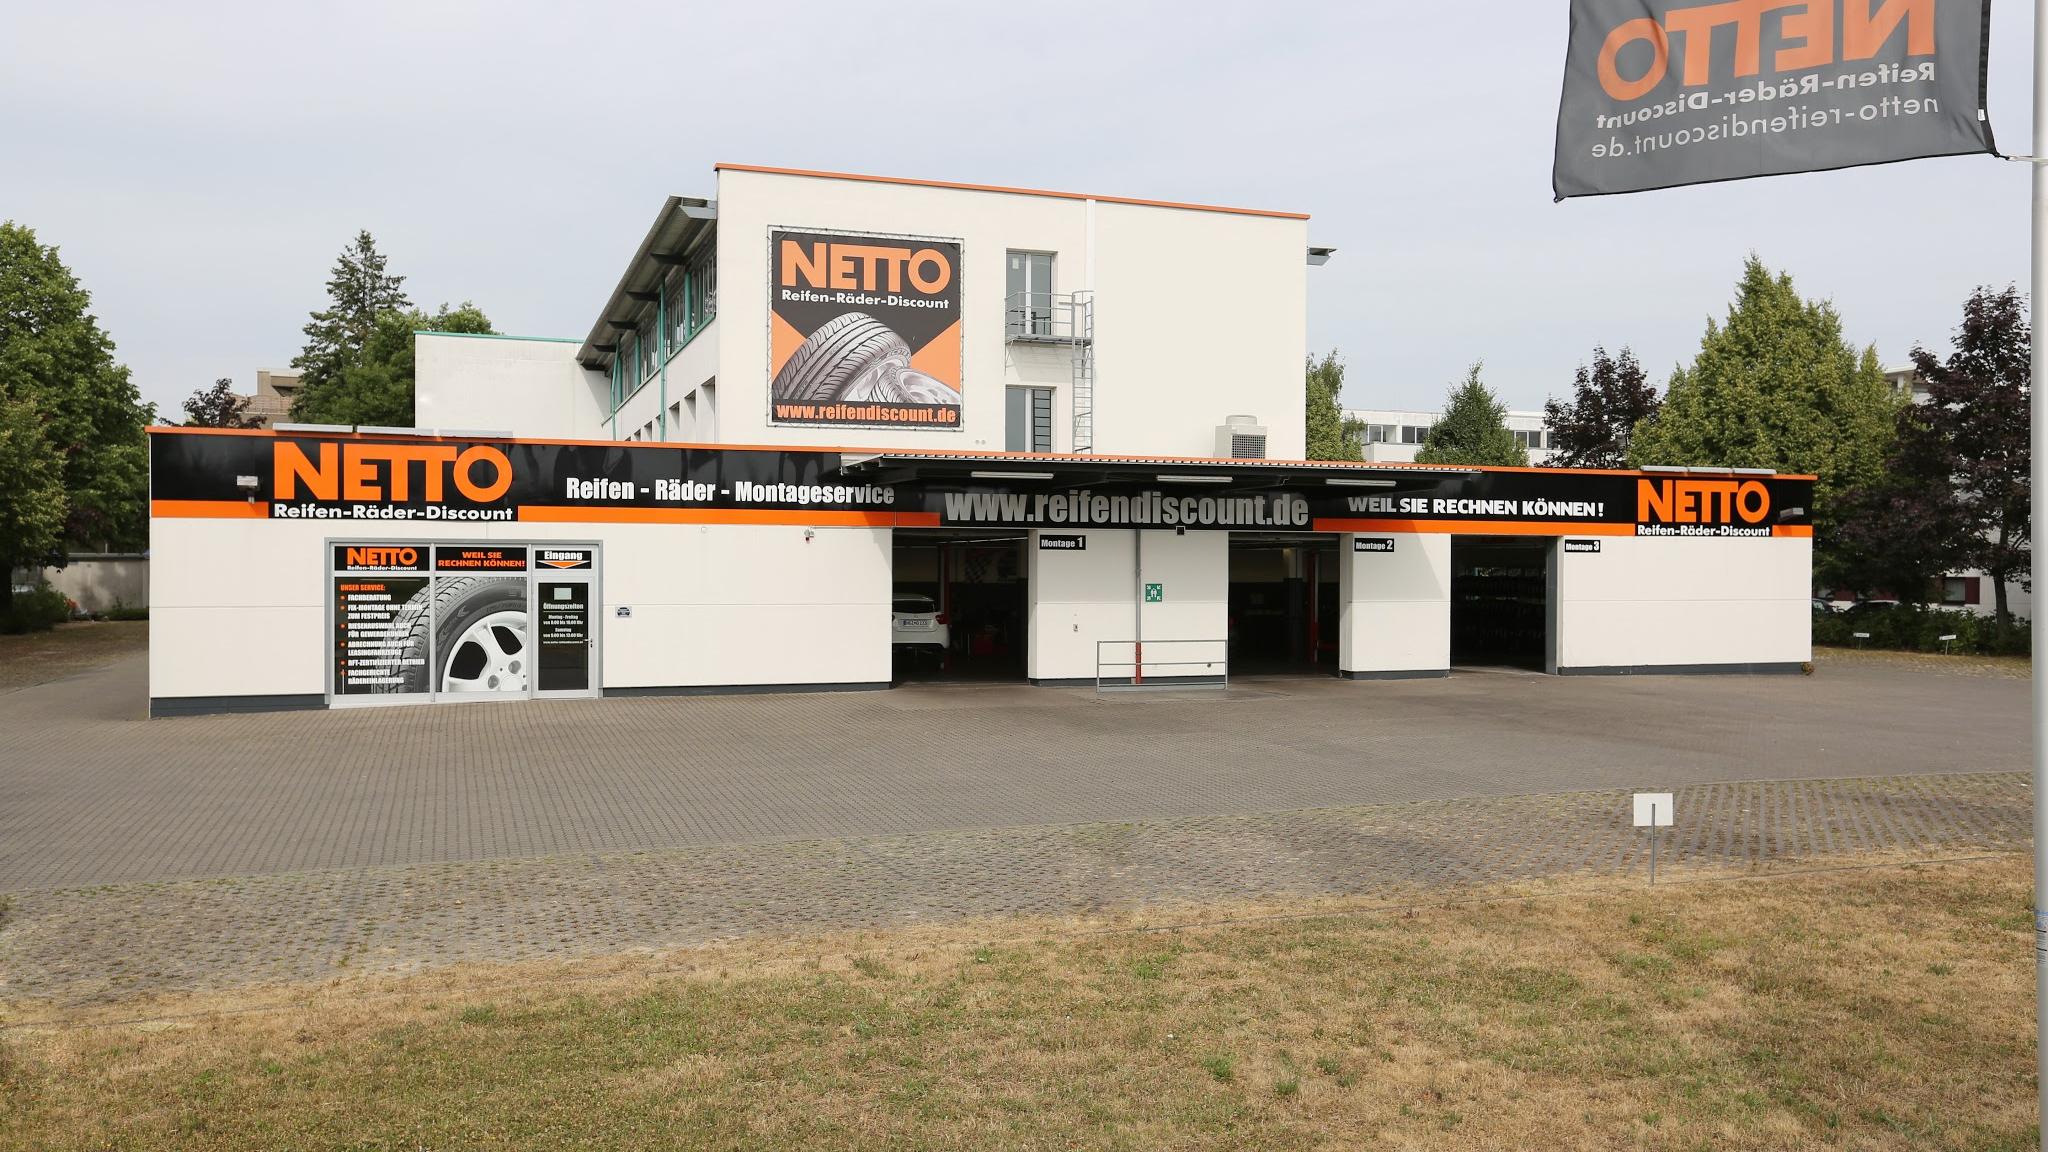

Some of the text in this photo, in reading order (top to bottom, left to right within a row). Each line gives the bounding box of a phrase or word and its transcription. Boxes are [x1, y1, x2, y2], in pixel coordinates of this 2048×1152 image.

[781, 239, 950, 294] NETTO
[781, 289, 949, 309] Reifen-Räder-Discount
[776, 404, 956, 423] www.reifendiscount.de
[273, 441, 513, 503] NETTO
[566, 477, 635, 500] Reifen
[655, 479, 716, 501] Räder
[735, 481, 895, 505] Montageservice
[944, 489, 1309, 527] www.reifendiscount.de
[1348, 496, 1397, 513] WEIL
[1399, 498, 1429, 514] SIE
[1433, 499, 1518, 515] RECHNEN
[1637, 479, 1771, 523] NETTO
[274, 502, 512, 521] Reifen-Räder-Discount
[1637, 524, 1770, 536] Reifen-Räder-Discount
[1041, 536, 1084, 549] Montage 1
[1355, 539, 1393, 551] Montage 2
[1565, 540, 1600, 552] Montage 3
[346, 547, 418, 566] NETTO
[461, 551, 502, 559] WEIL SIE
[484, 558, 525, 567] KÖNNEN!
[544, 551, 583, 561] Eingang
[347, 594, 391, 602] FACHBERATUNG
